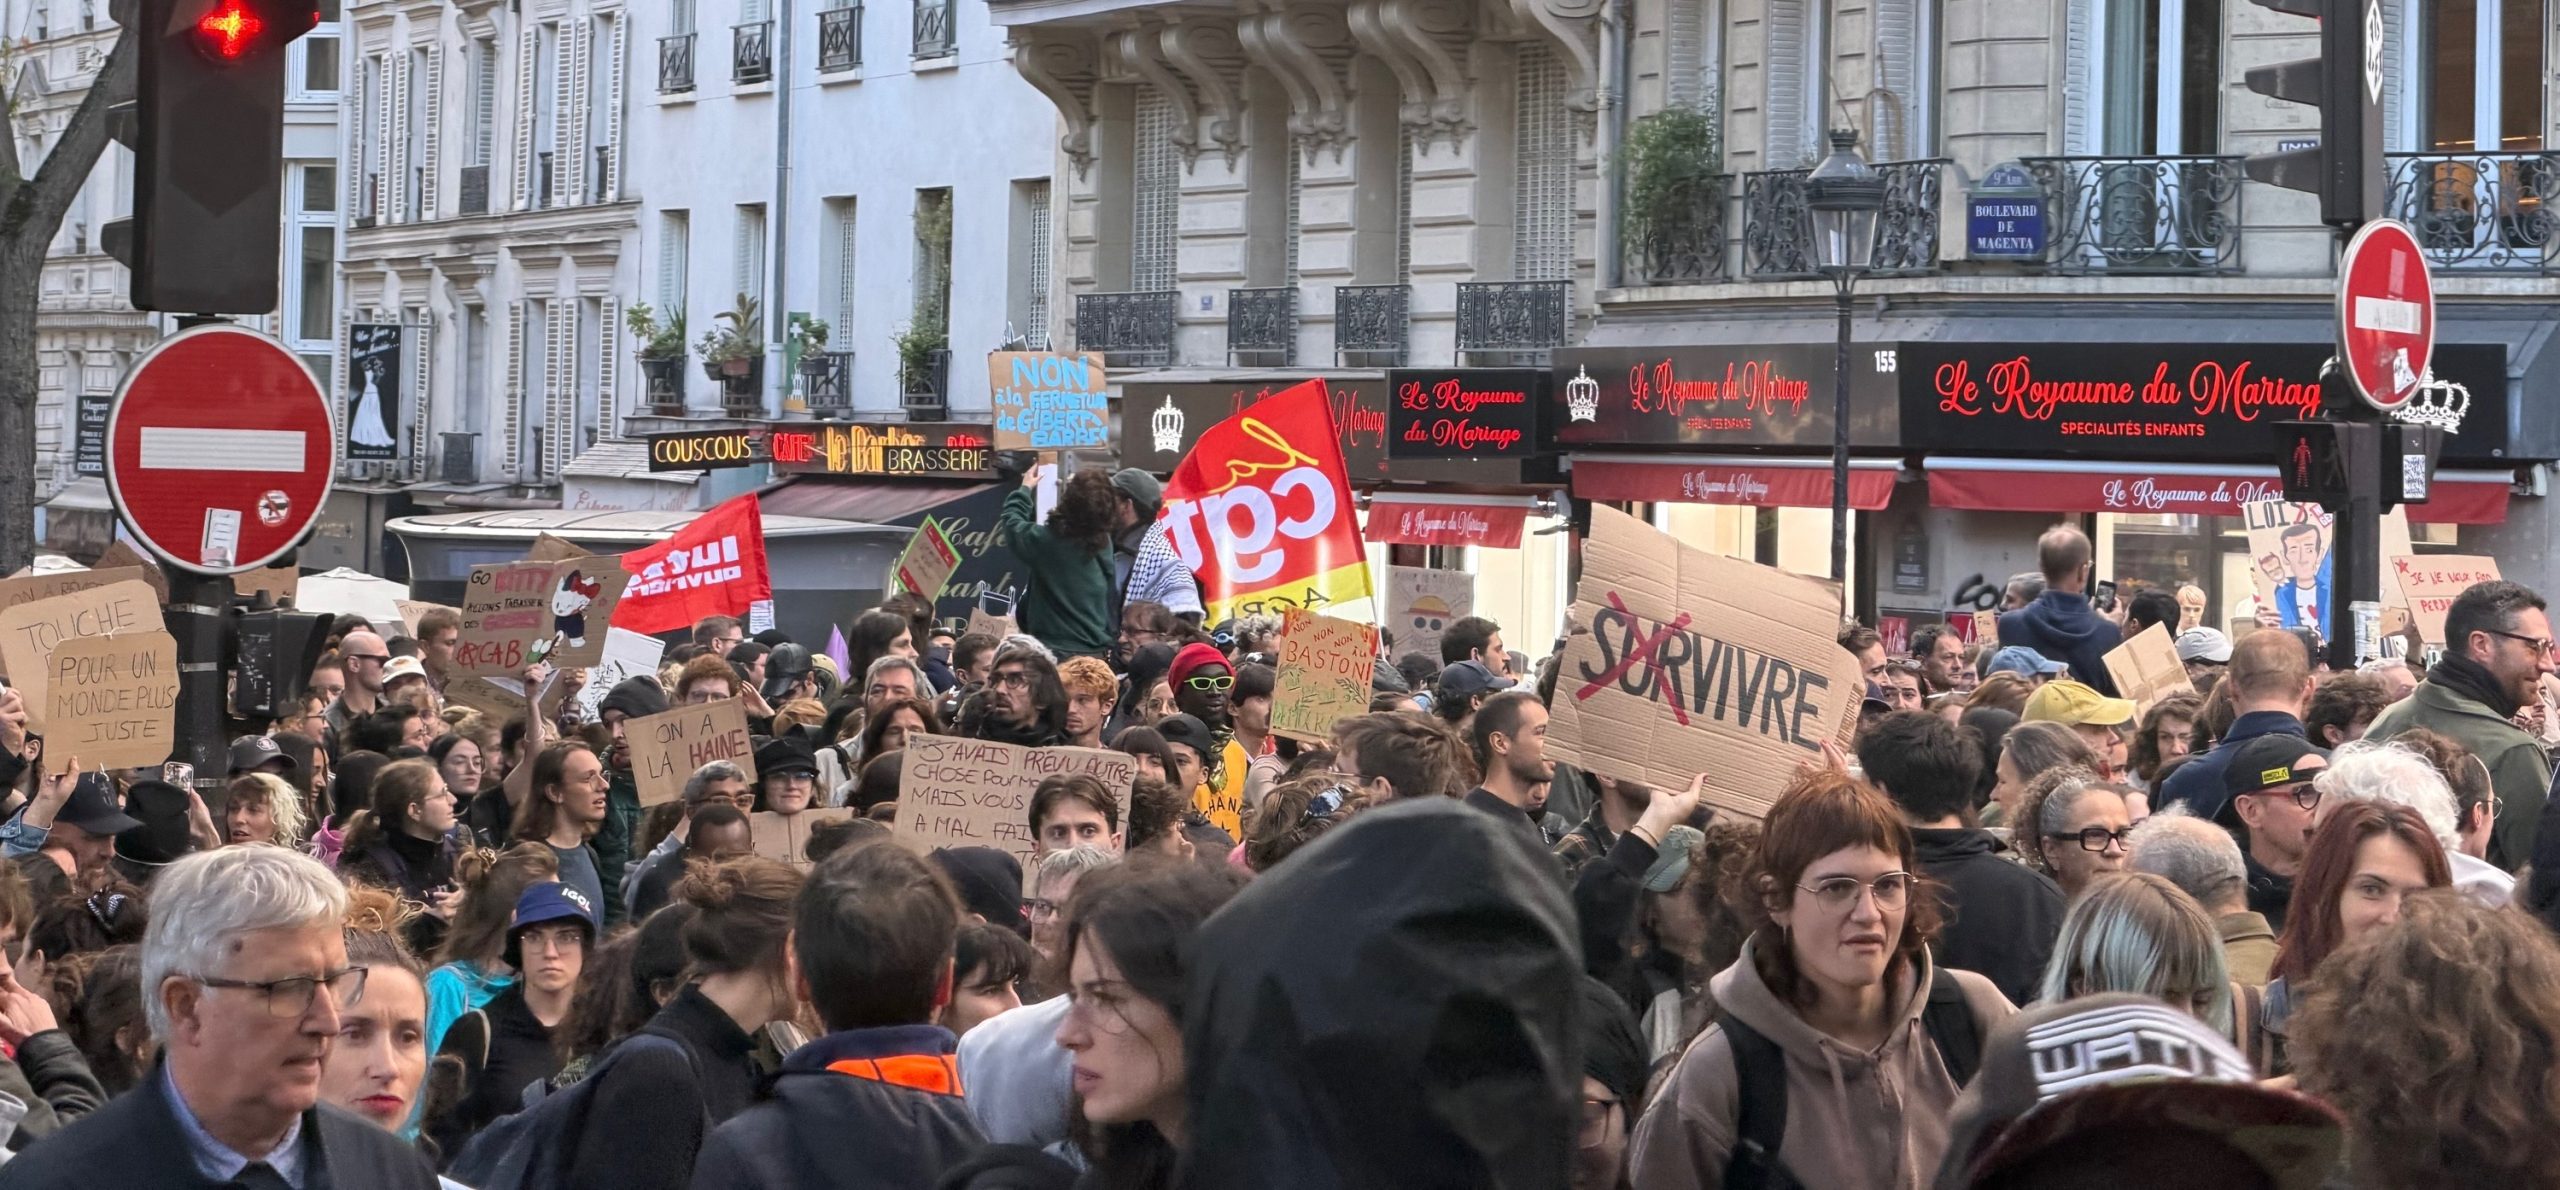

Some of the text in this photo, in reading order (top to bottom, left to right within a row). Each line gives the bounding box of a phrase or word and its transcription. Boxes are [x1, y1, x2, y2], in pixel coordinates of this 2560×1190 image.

[1975, 205, 2037, 217] BOULEVARD
[1998, 221, 2015, 233] DE
[1977, 237, 2034, 249] MAGENTA
[1012, 356, 1089, 390] NON
[1875, 351, 1896, 372] 155
[1400, 378, 1526, 413] Le Royaume
[1629, 357, 1809, 417] Le Royaume du Mariage
[1935, 359, 1983, 416] Le
[1986, 355, 2134, 421] Royaume
[2141, 361, 2181, 404] du
[2188, 359, 2322, 422] Mariag
[996, 410, 1016, 431] de
[1332, 390, 1385, 449] Mariag
[1404, 418, 1522, 450] du Mariage
[2145, 423, 2206, 438] ENFANTS
[654, 436, 752, 463] COUSCOUS
[888, 448, 989, 471] BRASSERIE
[1682, 472, 1695, 497] Le
[1695, 470, 1726, 500] Royaume
[1736, 473, 1768, 501] Mariage
[2102, 478, 2285, 509] Le Royaume du Mari
[1401, 508, 1489, 540] Le Royaume du Mariage
[470, 569, 491, 585] GO
[2410, 572, 2424, 586] JE
[466, 602, 501, 615] ALLONS
[17, 600, 135, 653] TOUCHE
[1293, 618, 1313, 634] NON
[1313, 626, 1335, 643] NON
[1334, 633, 1354, 648] NON
[61, 654, 118, 687] POUR
[132, 650, 157, 679] UN
[456, 639, 522, 670] ACAB
[1579, 606, 1830, 753] SURVIVRE
[58, 685, 176, 719] MONDE PLUS
[80, 719, 159, 744] JUSTE
[656, 714, 715, 744] ON A
[647, 728, 749, 779] LA HAINE
[919, 740, 1010, 766] J'AVAIS
[1023, 750, 1077, 775] PRÉVU
[913, 763, 979, 783] CHOSE
[911, 787, 1025, 811] MAIS VOUS
[915, 813, 1033, 842] A MAL FAI
[561, 887, 591, 912] IGOL
